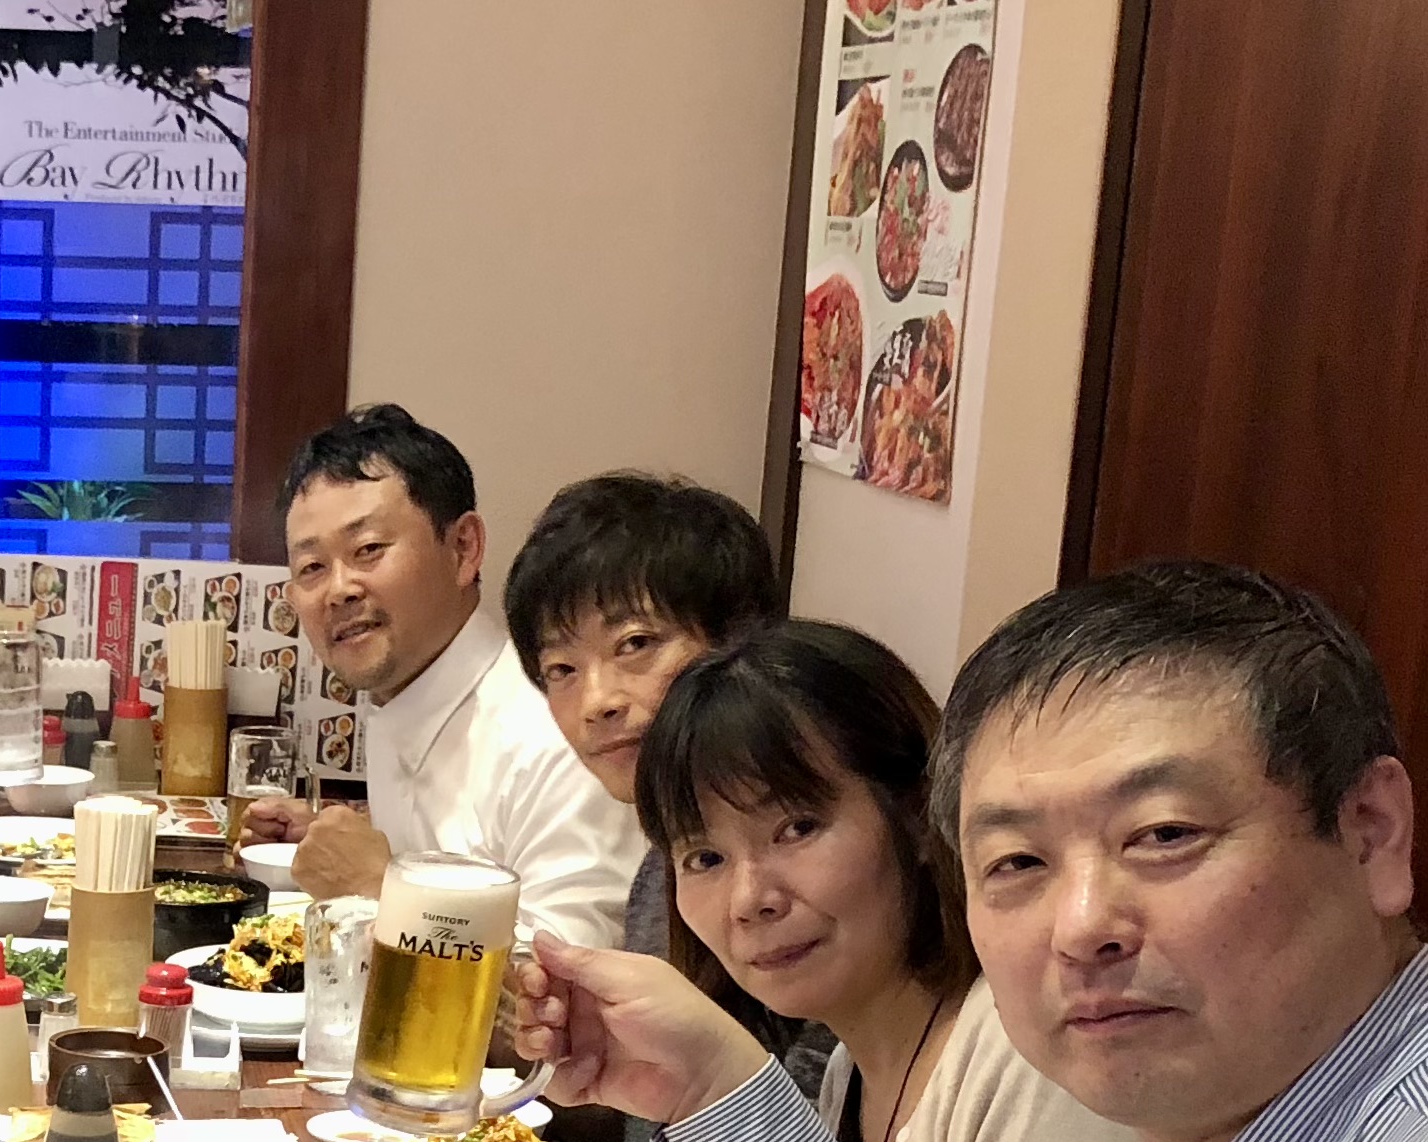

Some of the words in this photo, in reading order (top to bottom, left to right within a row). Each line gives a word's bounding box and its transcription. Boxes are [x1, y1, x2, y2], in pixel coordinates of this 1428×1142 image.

[24, 120, 59, 139] The
[63, 121, 187, 143] Entertainment
[0, 142, 86, 200] Bay
[422, 911, 471, 926] SUNTORY
[427, 926, 459, 941] The
[398, 931, 485, 962] MALT'S
